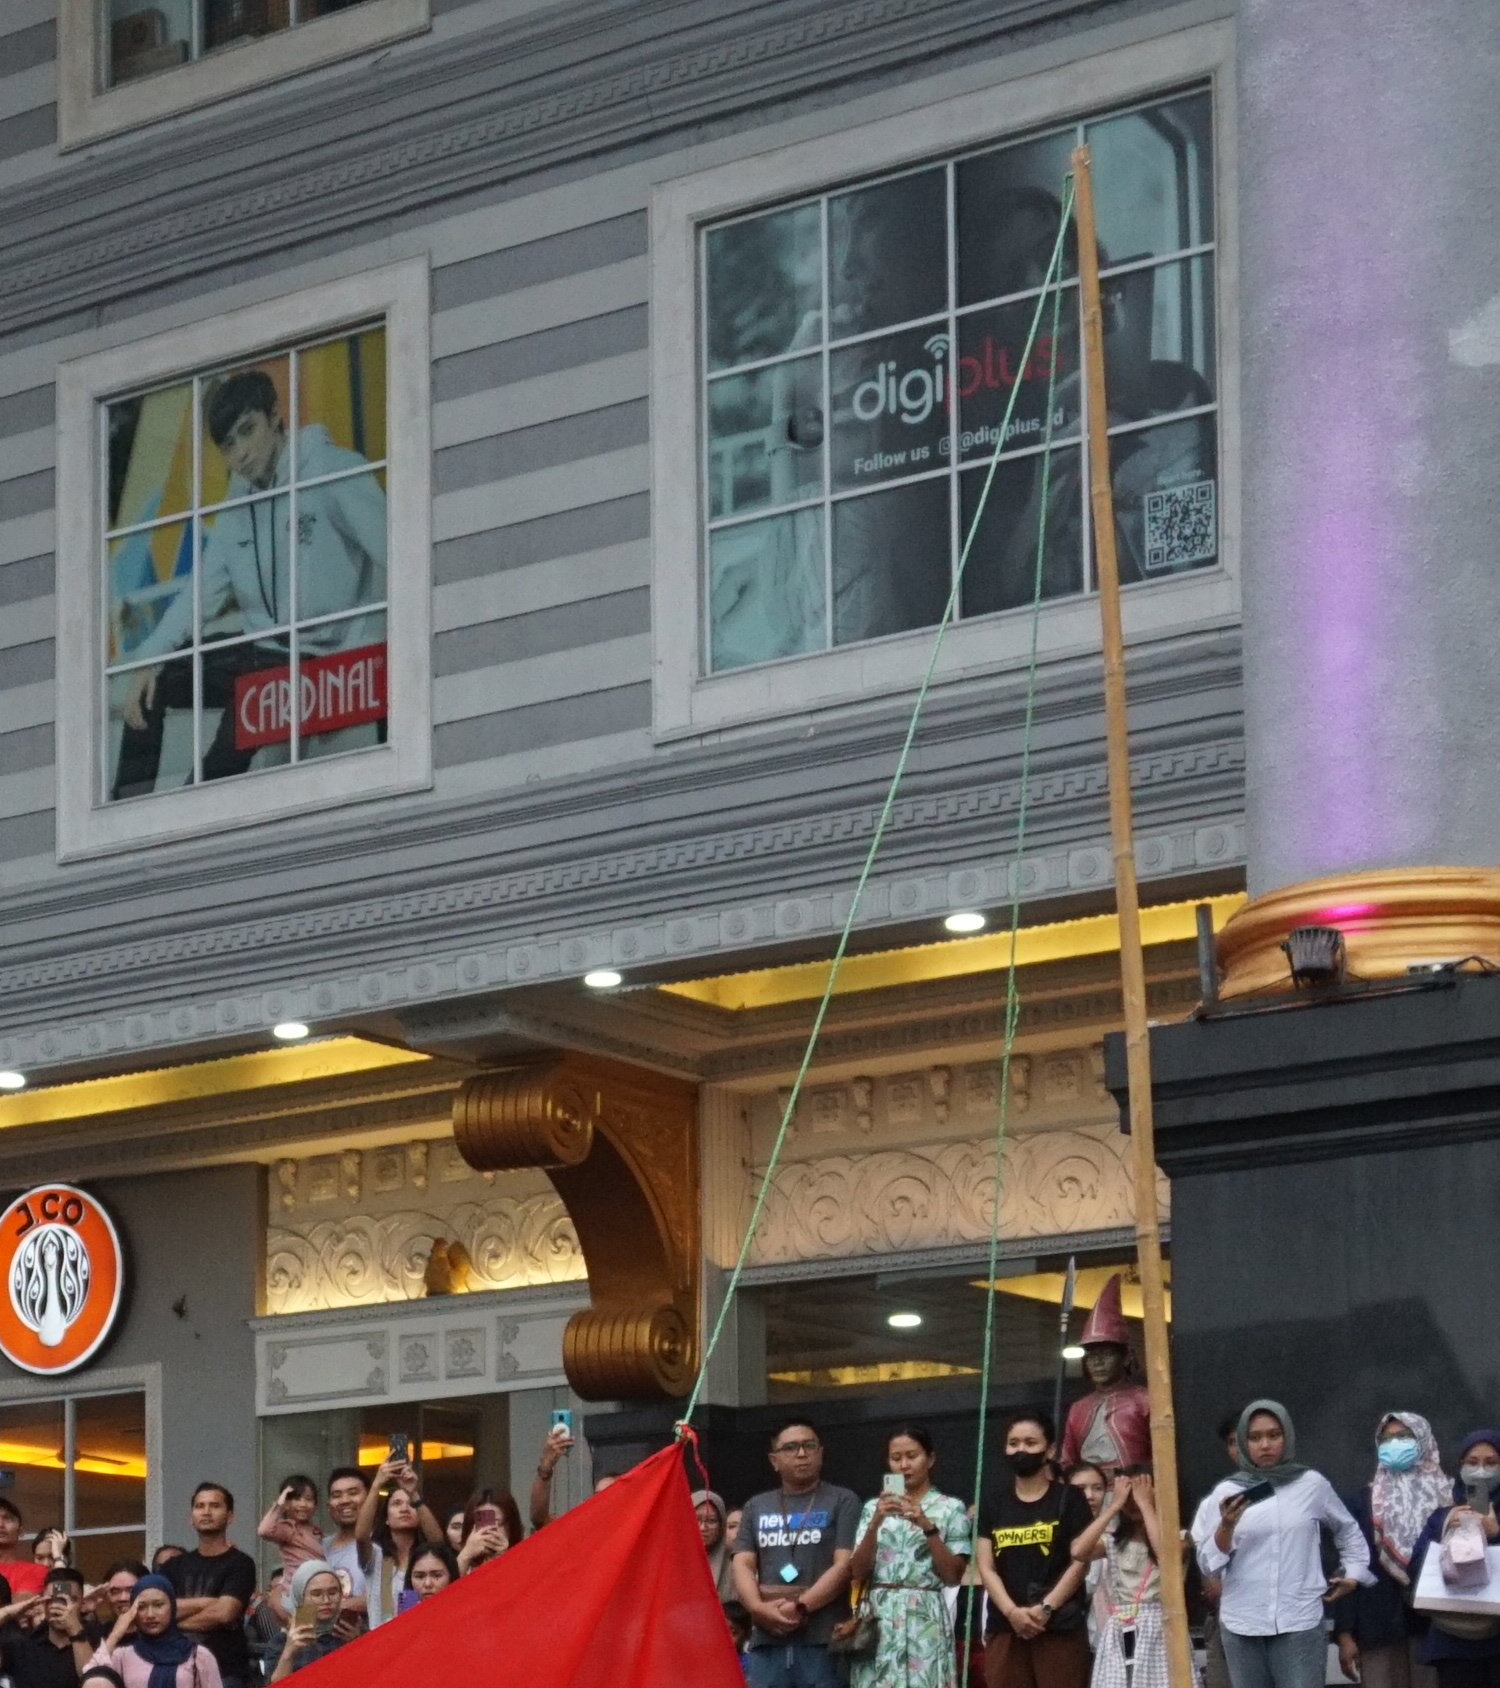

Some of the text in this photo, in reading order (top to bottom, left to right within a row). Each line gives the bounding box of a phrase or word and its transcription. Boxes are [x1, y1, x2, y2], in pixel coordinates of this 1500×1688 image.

[852, 334, 1064, 424] digiplus
[854, 451, 906, 475] Follow
[910, 445, 930, 462] us
[240, 657, 380, 734] CARDINAL
[15, 1193, 83, 1237] J.CO
[758, 1529, 822, 1548] balance
